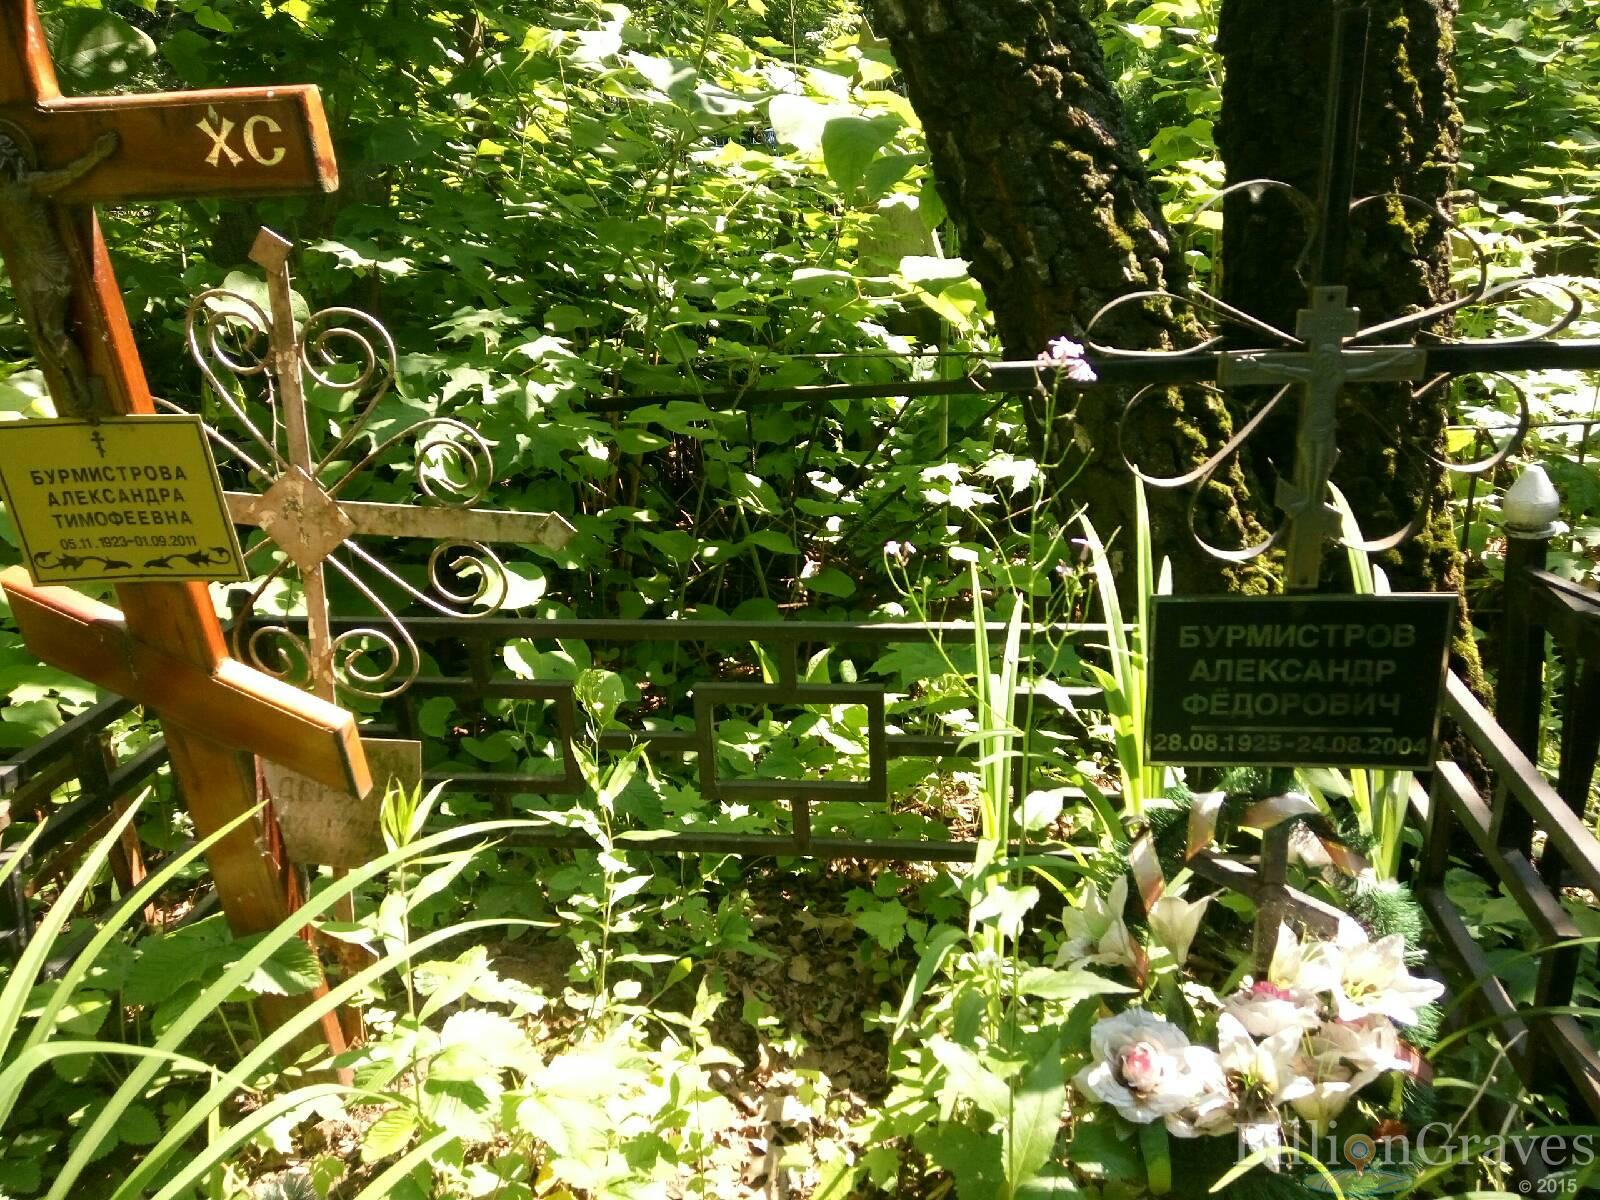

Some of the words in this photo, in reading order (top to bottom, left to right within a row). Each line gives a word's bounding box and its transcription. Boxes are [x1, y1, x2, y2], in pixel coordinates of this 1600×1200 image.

[30, 465, 187, 486] БУРМИСТРОВА
[48, 487, 185, 507] АЛЕКСАНДРА
[52, 510, 192, 529] ТИМОФЕЕВНА
[1179, 624, 1416, 648] БУРМИСТРОВ
[1188, 658, 1397, 686] АЛЕКСАНДР
[1182, 688, 1400, 717] ФЁДОРОВИЧ
